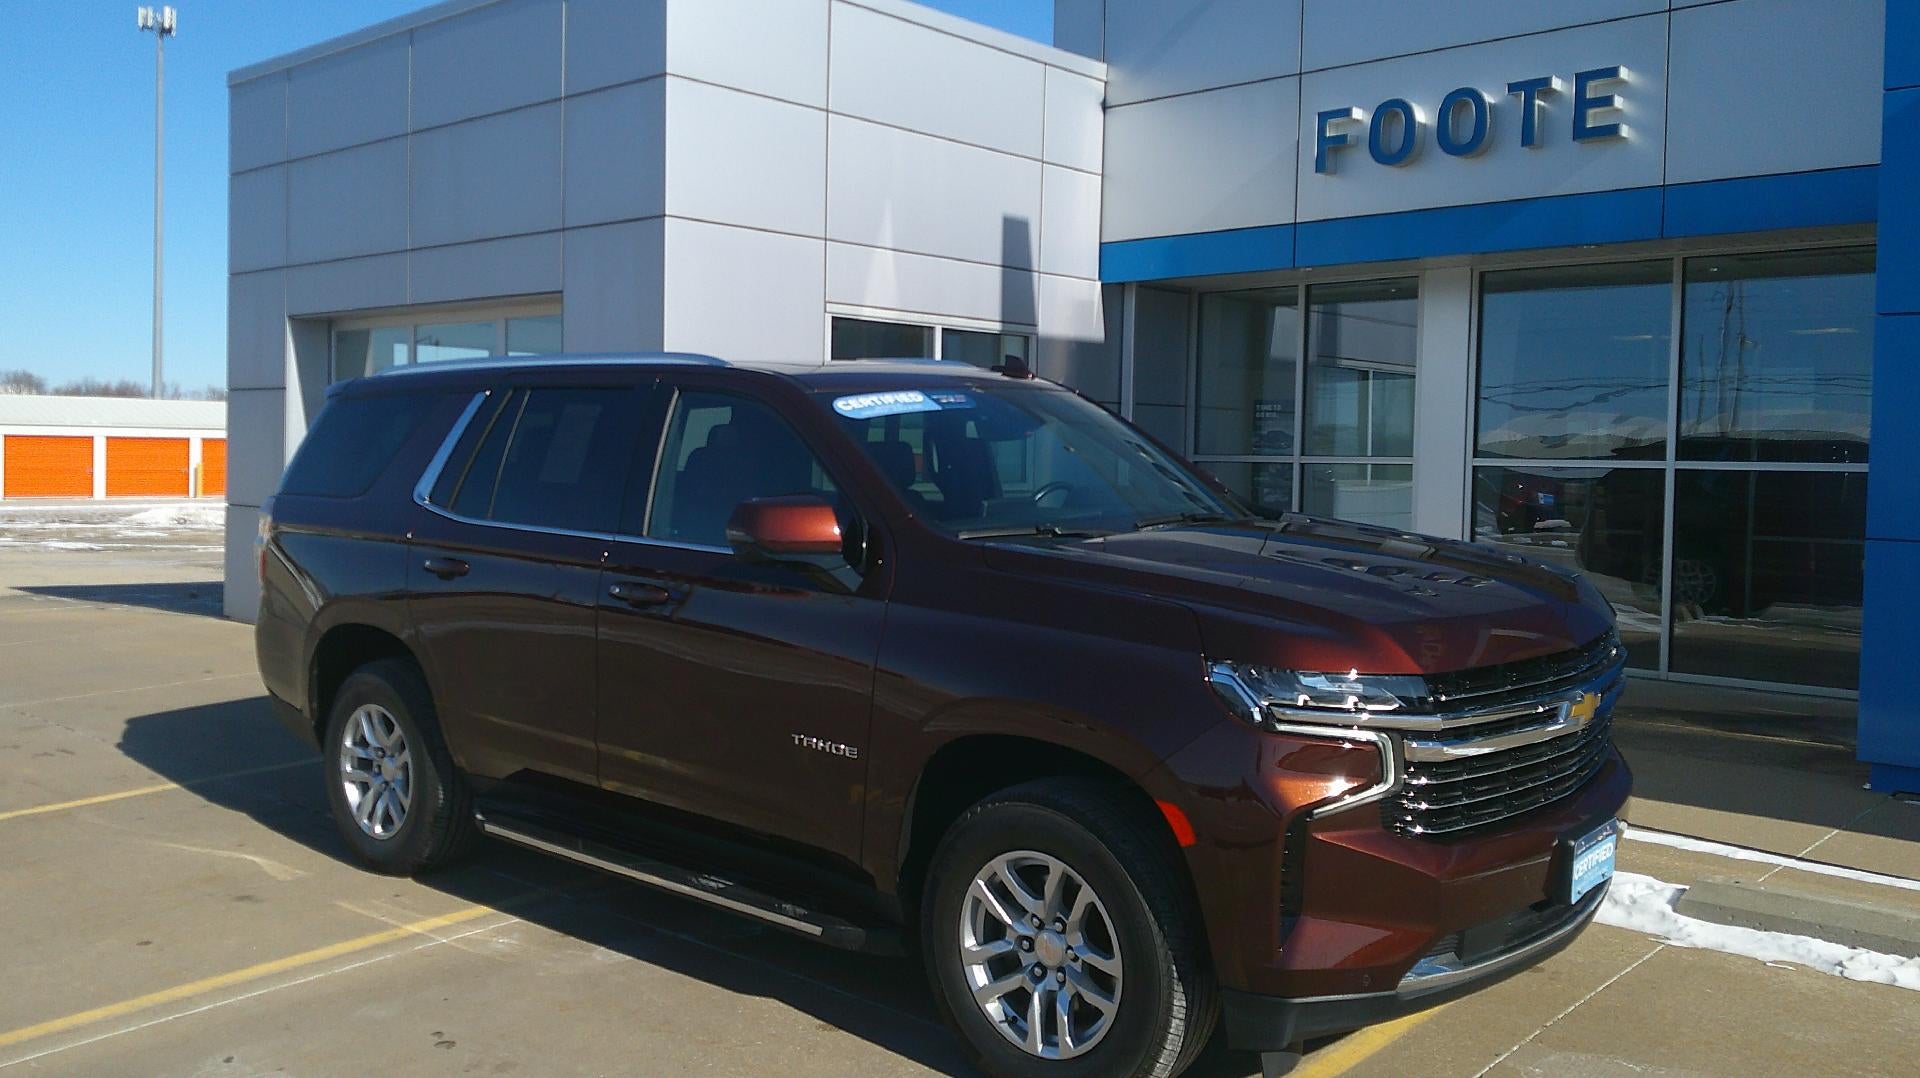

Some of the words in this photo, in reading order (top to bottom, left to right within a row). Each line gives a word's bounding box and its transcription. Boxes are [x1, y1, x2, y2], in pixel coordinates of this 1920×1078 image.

[1314, 65, 1628, 174] FOOTE
[836, 391, 924, 410] CERTIFIED
[791, 733, 859, 759] TAHOE
[1574, 842, 1614, 881] CERTIFIED
